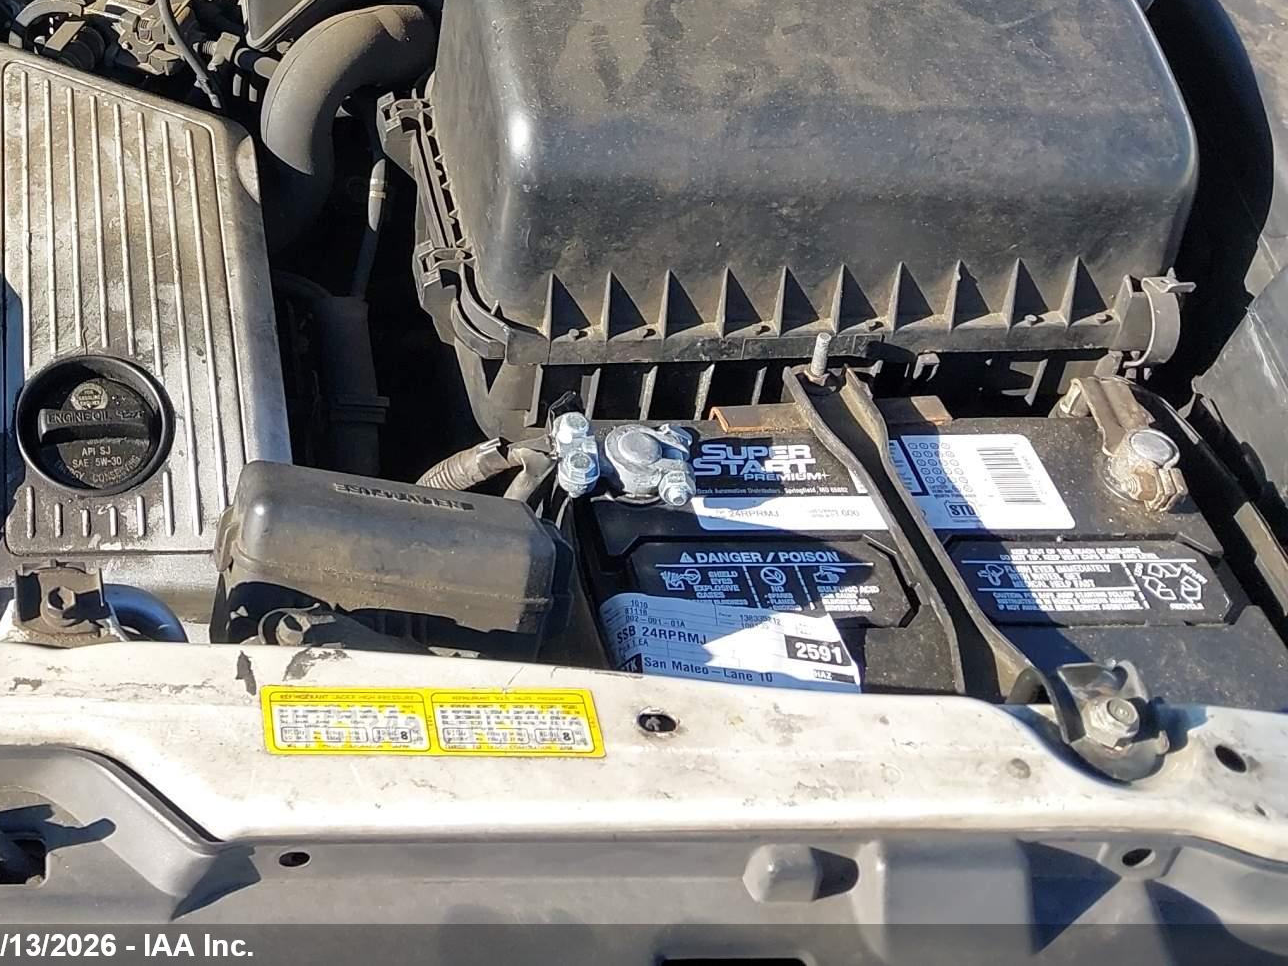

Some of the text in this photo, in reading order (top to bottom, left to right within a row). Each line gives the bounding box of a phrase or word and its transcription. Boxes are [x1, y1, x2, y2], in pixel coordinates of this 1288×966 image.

[81, 445, 112, 457] API SJ
[702, 444, 812, 460] SUPER
[72, 456, 123, 470] SAE 5W-30
[693, 458, 817, 476] START
[695, 552, 762, 564] DANGER
[779, 551, 841, 563] POISON
[616, 624, 707, 645] SSB 24RPRMJ
[794, 641, 843, 664] 2591
[643, 656, 667, 669] San
[671, 659, 710, 675] Mateo
[723, 667, 754, 682] Lane
[759, 672, 773, 683] 10
